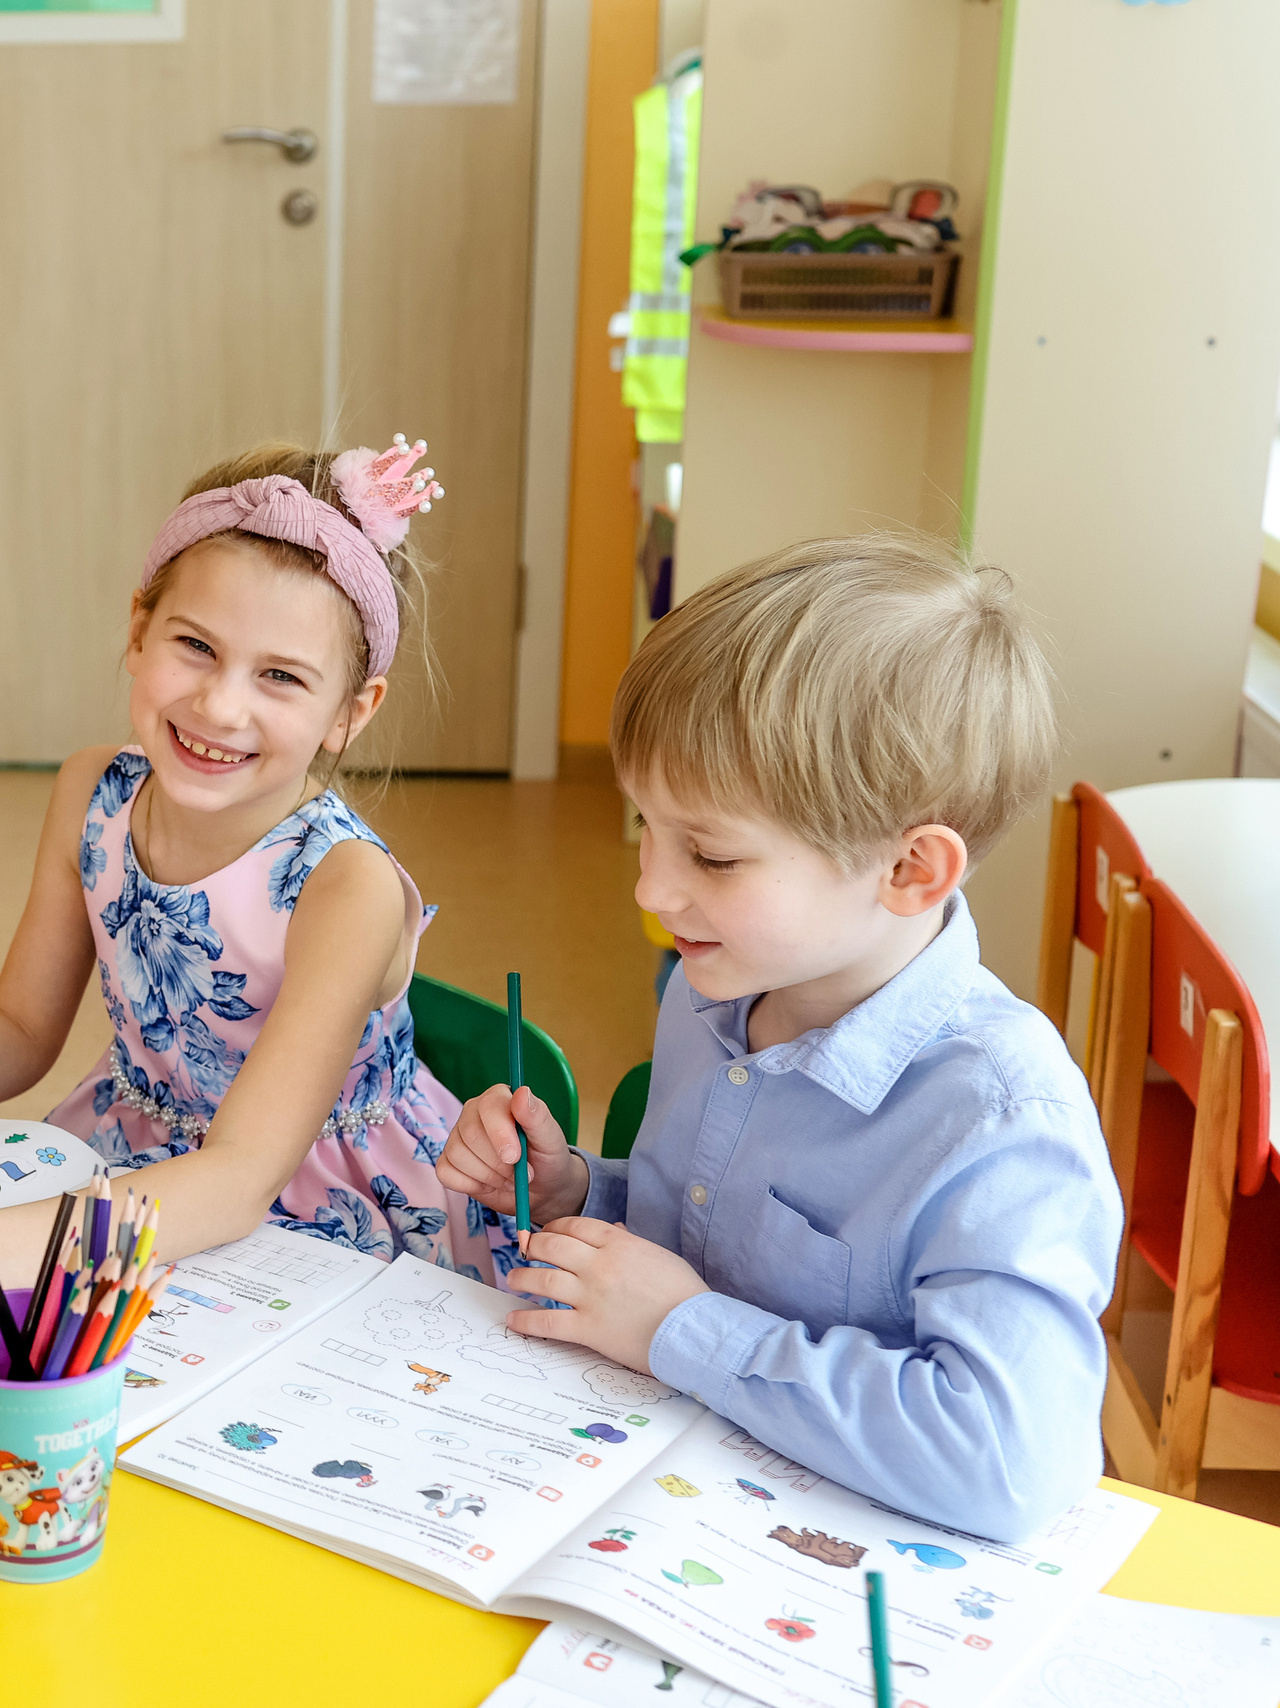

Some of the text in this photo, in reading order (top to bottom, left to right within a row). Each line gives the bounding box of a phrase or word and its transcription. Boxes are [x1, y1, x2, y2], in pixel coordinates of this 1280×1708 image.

[234, 1292, 265, 1304] Задание
[146, 1345, 178, 1358] Задание
[292, 1388, 318, 1401] ИА!
[354, 1410, 388, 1425] УУУ!
[584, 1407, 620, 1419] Задание
[427, 1434, 454, 1446] УА!
[534, 1444, 572, 1459] Задание
[498, 1454, 525, 1465] АУ!
[494, 1476, 533, 1491] Задание
[424, 1532, 464, 1549] Задание
